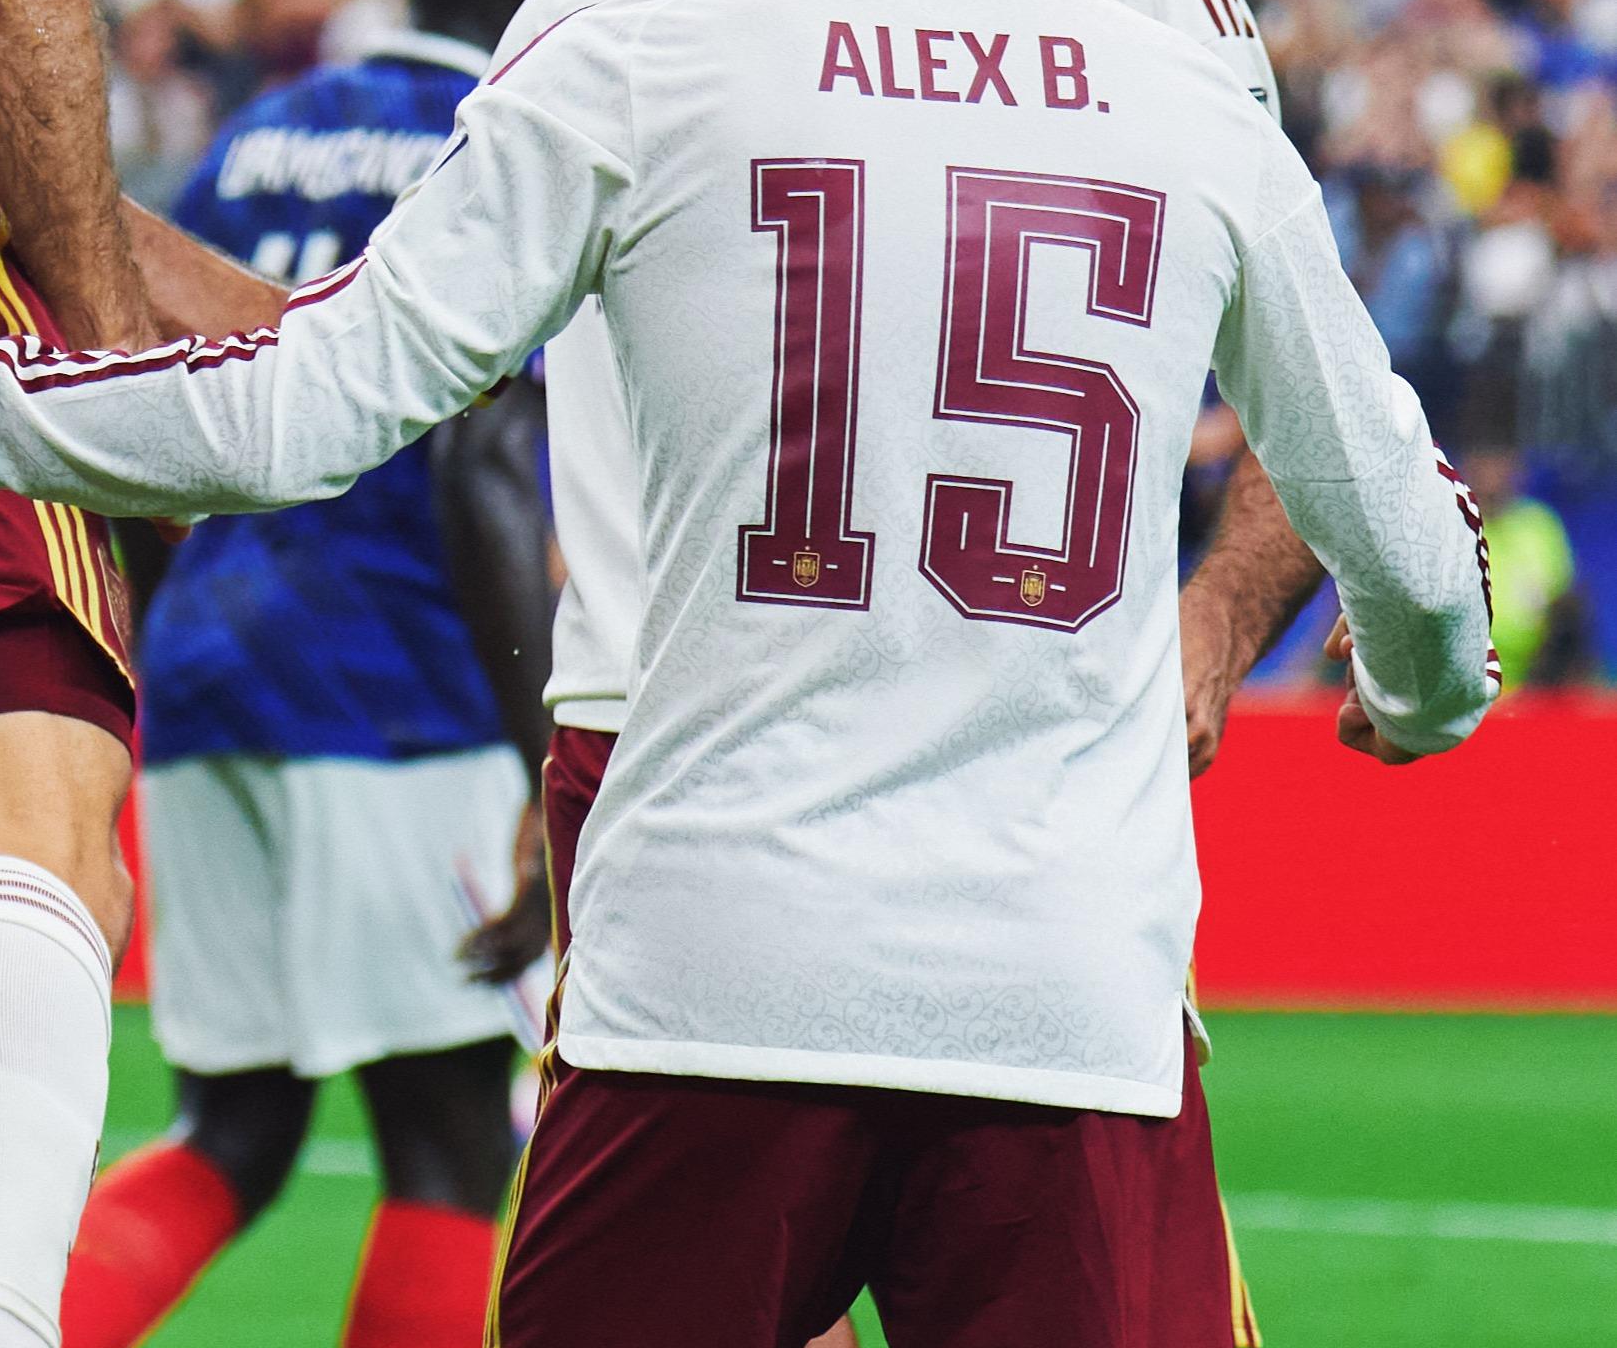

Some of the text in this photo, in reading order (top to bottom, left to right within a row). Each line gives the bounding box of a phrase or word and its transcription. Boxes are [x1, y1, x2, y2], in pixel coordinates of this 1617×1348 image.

[818, 20, 1110, 114] ALEX B.
[736, 158, 1167, 635] 15
